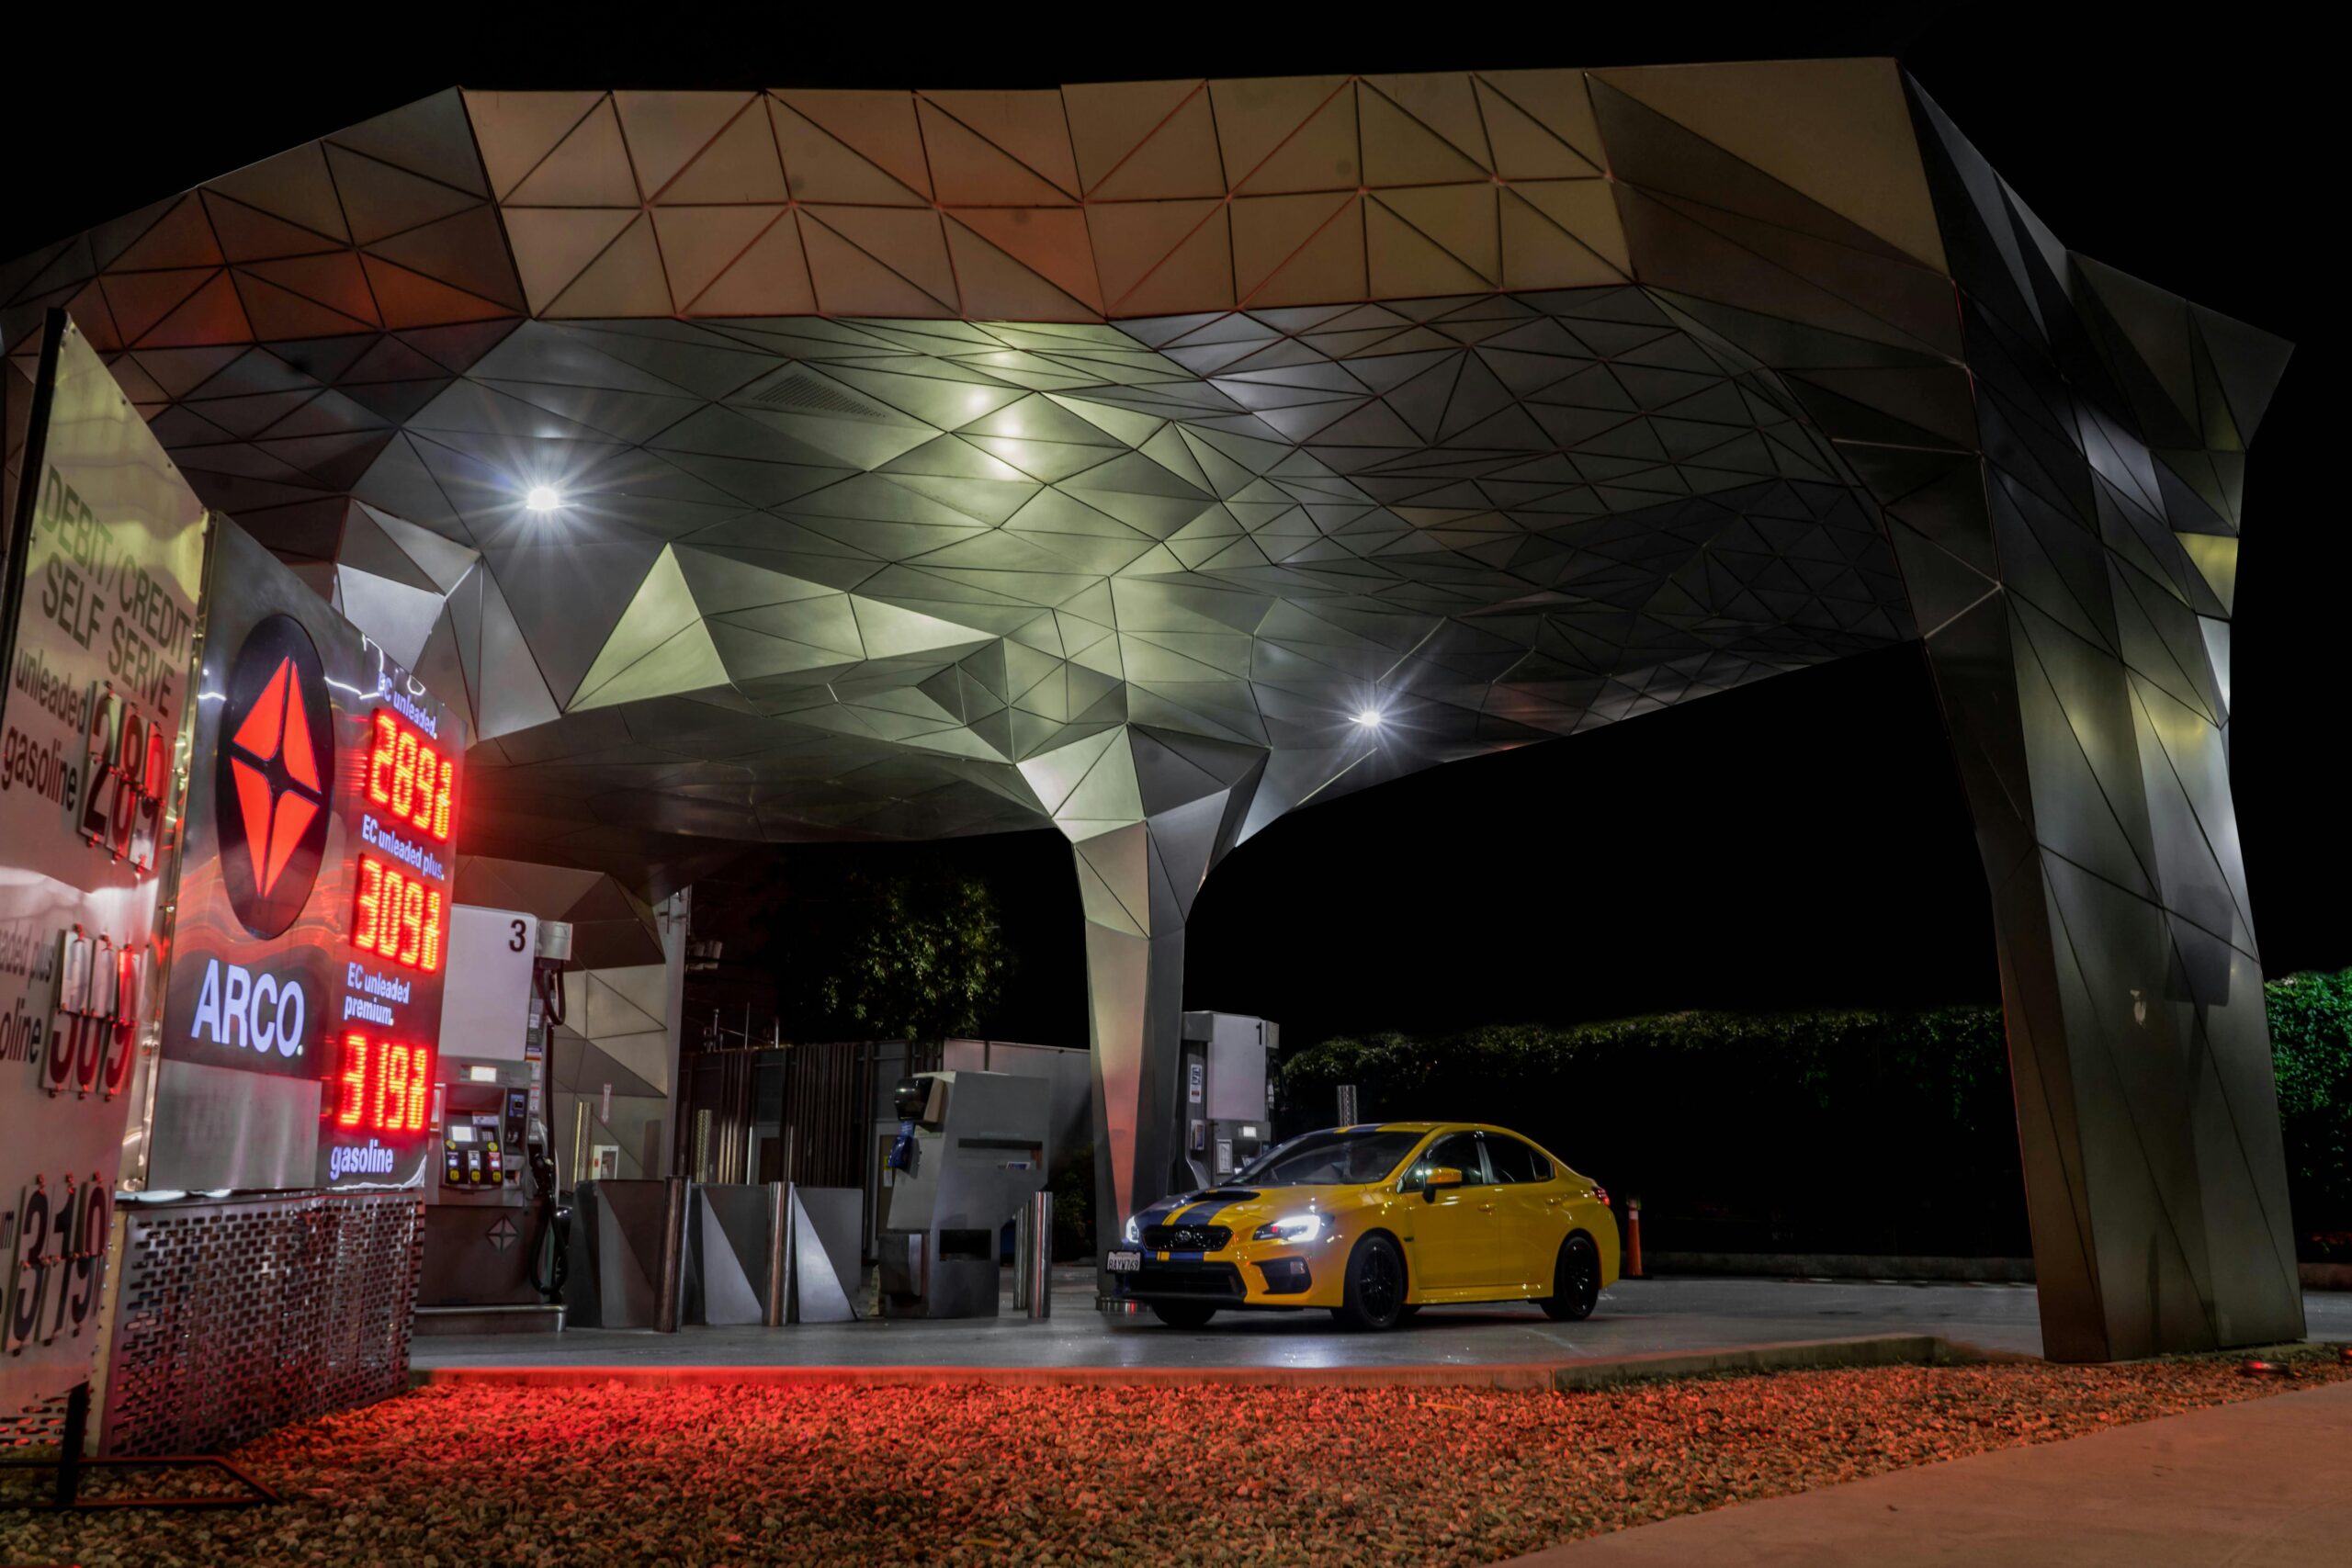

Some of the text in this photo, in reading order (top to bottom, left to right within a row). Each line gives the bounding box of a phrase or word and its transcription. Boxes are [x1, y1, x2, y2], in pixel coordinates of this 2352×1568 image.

[42, 551, 175, 718] SELF SERVE
[16, 648, 89, 735] unleaded
[379, 671, 392, 702] EC
[2, 726, 77, 812] gasoline
[362, 814, 378, 843] EC
[379, 830, 422, 870] unleaded
[509, 919, 526, 952] 3
[347, 962, 410, 1005] EC unleaded
[1256, 1021, 1262, 1045] 1
[330, 1139, 394, 1180] gasoline
[14, 1185, 107, 1342] 319
